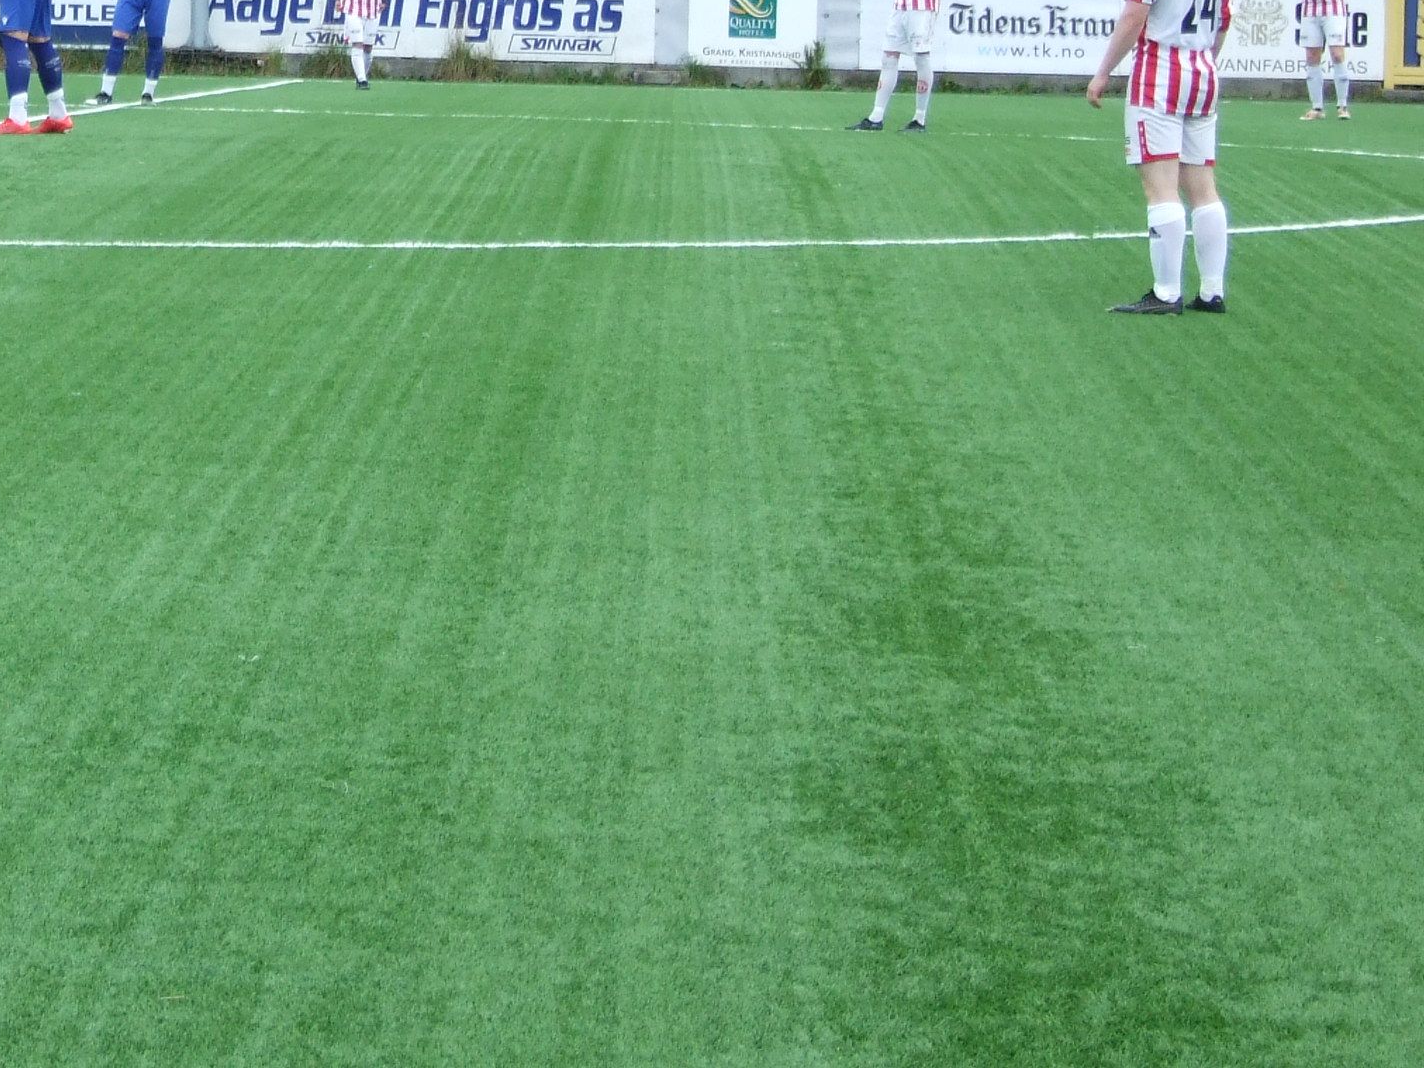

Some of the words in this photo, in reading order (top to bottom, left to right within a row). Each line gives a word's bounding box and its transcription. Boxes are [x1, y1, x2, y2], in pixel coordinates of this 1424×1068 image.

[51, 4, 115, 22] UTLE
[949, 2, 1041, 36] Tidens
[1044, 4, 1115, 37] Krav
[730, 17, 775, 30] QUALITY
[977, 42, 1085, 59] www.tk.no
[1347, 60, 1368, 75] AS
